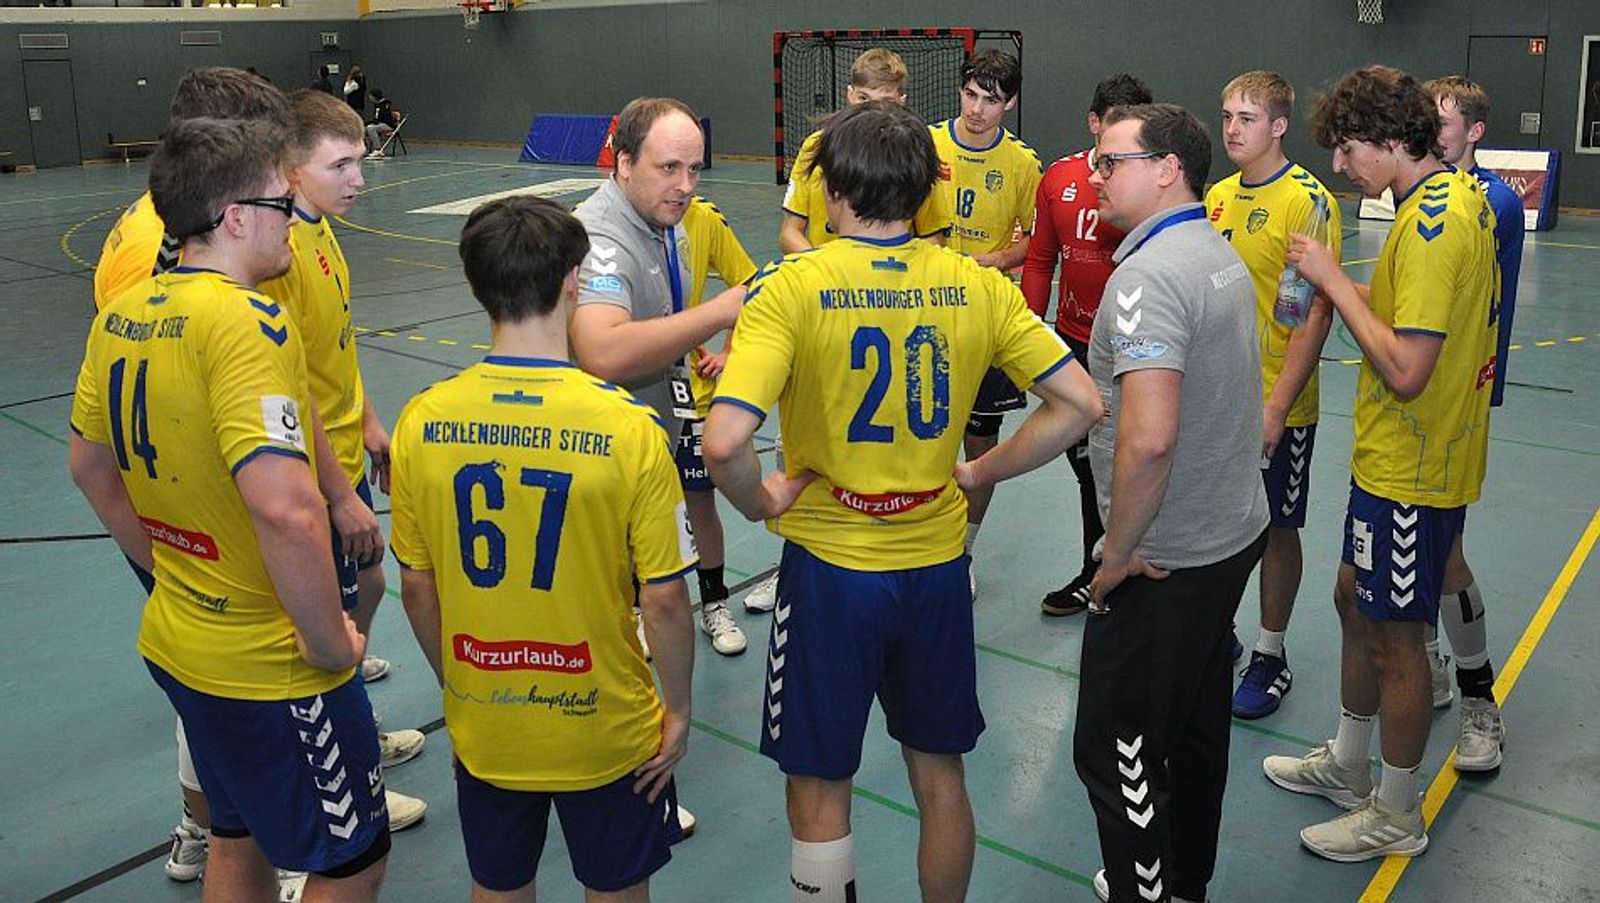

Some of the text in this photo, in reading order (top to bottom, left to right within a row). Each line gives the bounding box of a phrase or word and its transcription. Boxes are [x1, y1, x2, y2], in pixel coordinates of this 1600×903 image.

[956, 187, 976, 218] 18
[1076, 208, 1099, 241] 12
[672, 381, 689, 403] B
[847, 325, 949, 443] 20
[109, 357, 157, 478] 14
[423, 421, 613, 456] MECKLENBURGER STIERE
[453, 459, 573, 592] 67
[462, 640, 585, 668] Kurzurlaub.de
